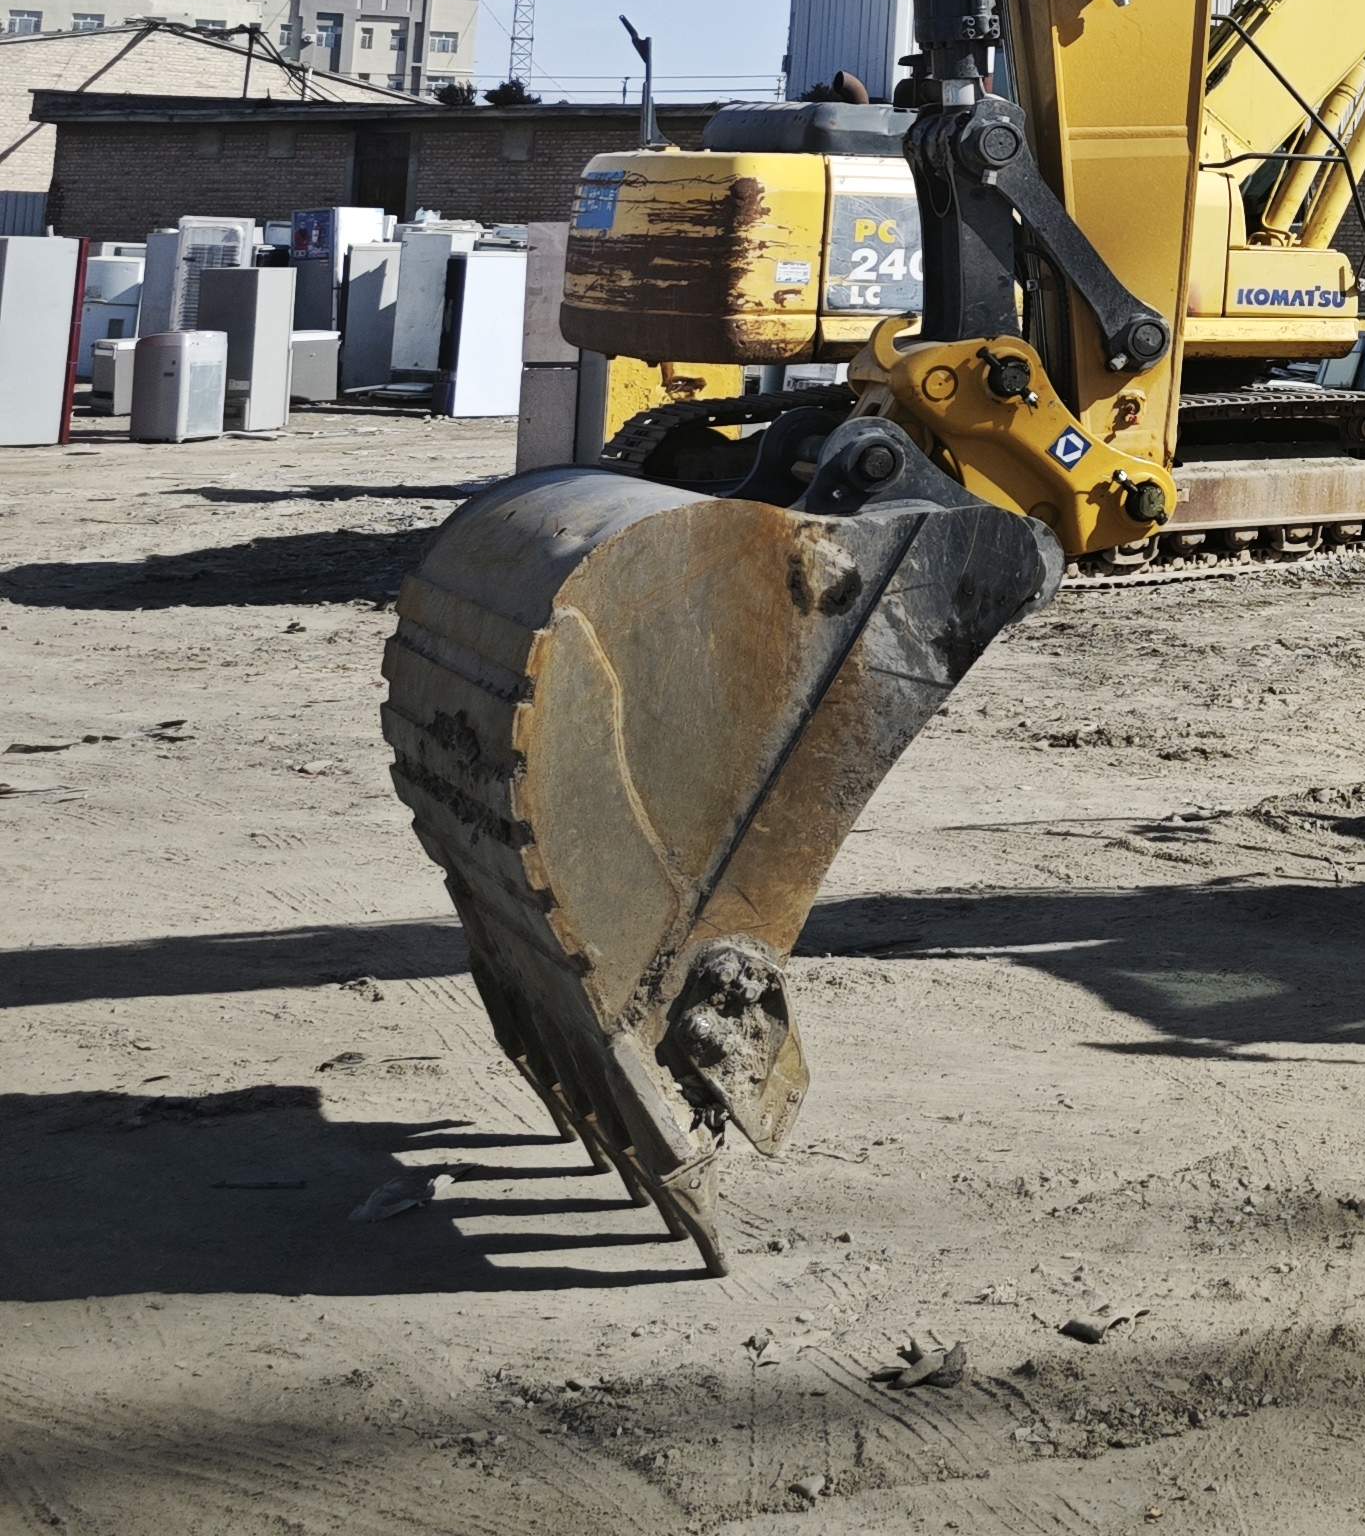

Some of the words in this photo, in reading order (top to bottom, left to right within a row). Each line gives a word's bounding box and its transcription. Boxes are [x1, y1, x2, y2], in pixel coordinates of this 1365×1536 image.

[853, 218, 898, 243] PC
[849, 285, 881, 305] LC
[1237, 285, 1346, 308] KOMATSU
